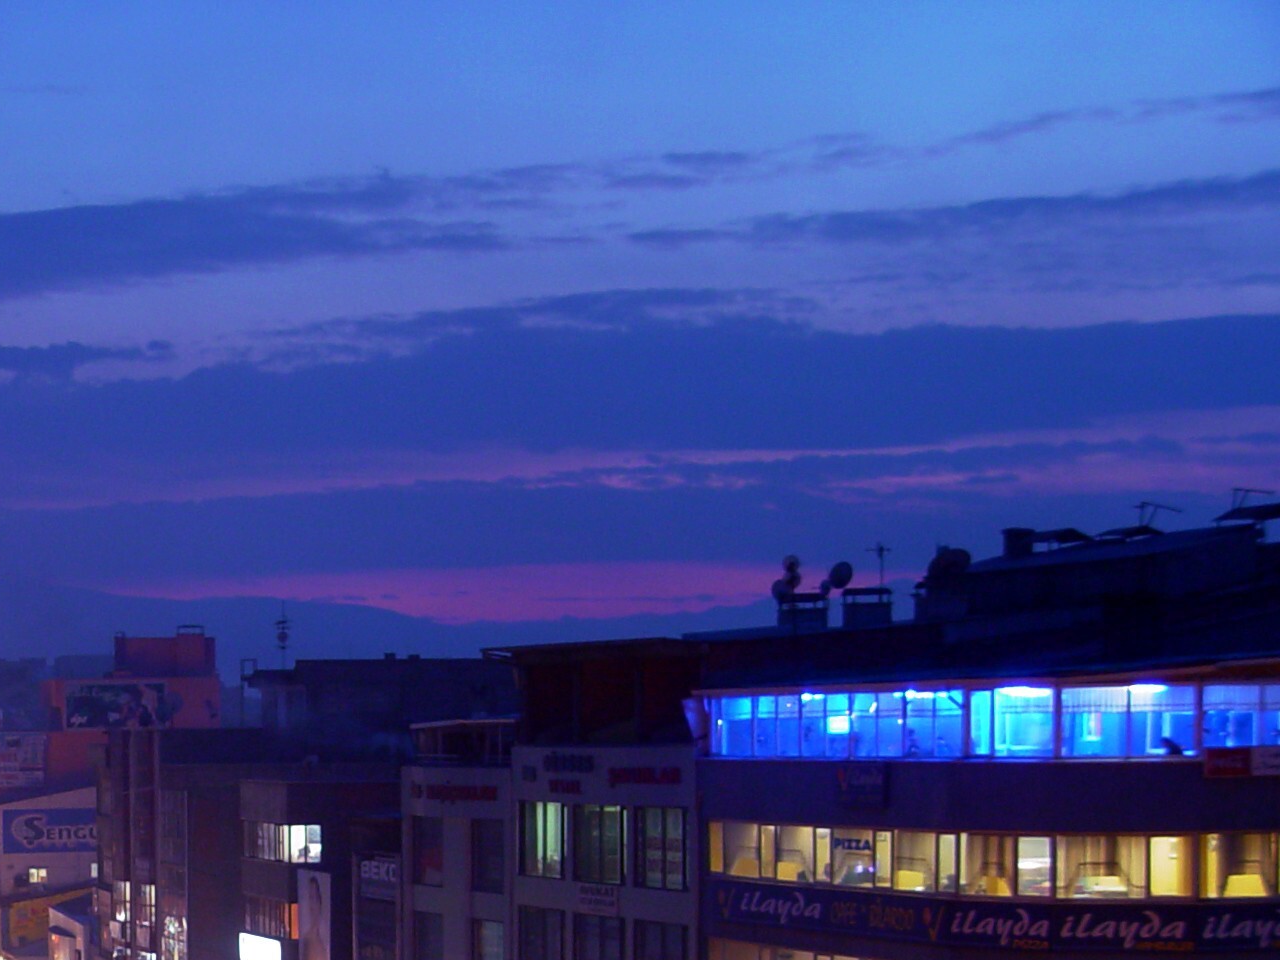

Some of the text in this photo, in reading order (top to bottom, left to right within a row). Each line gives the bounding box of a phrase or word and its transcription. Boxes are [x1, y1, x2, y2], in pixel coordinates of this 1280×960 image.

[740, 891, 821, 924] ilayda
[950, 909, 1050, 946] ilayda
[1060, 911, 1186, 948] ilayda
